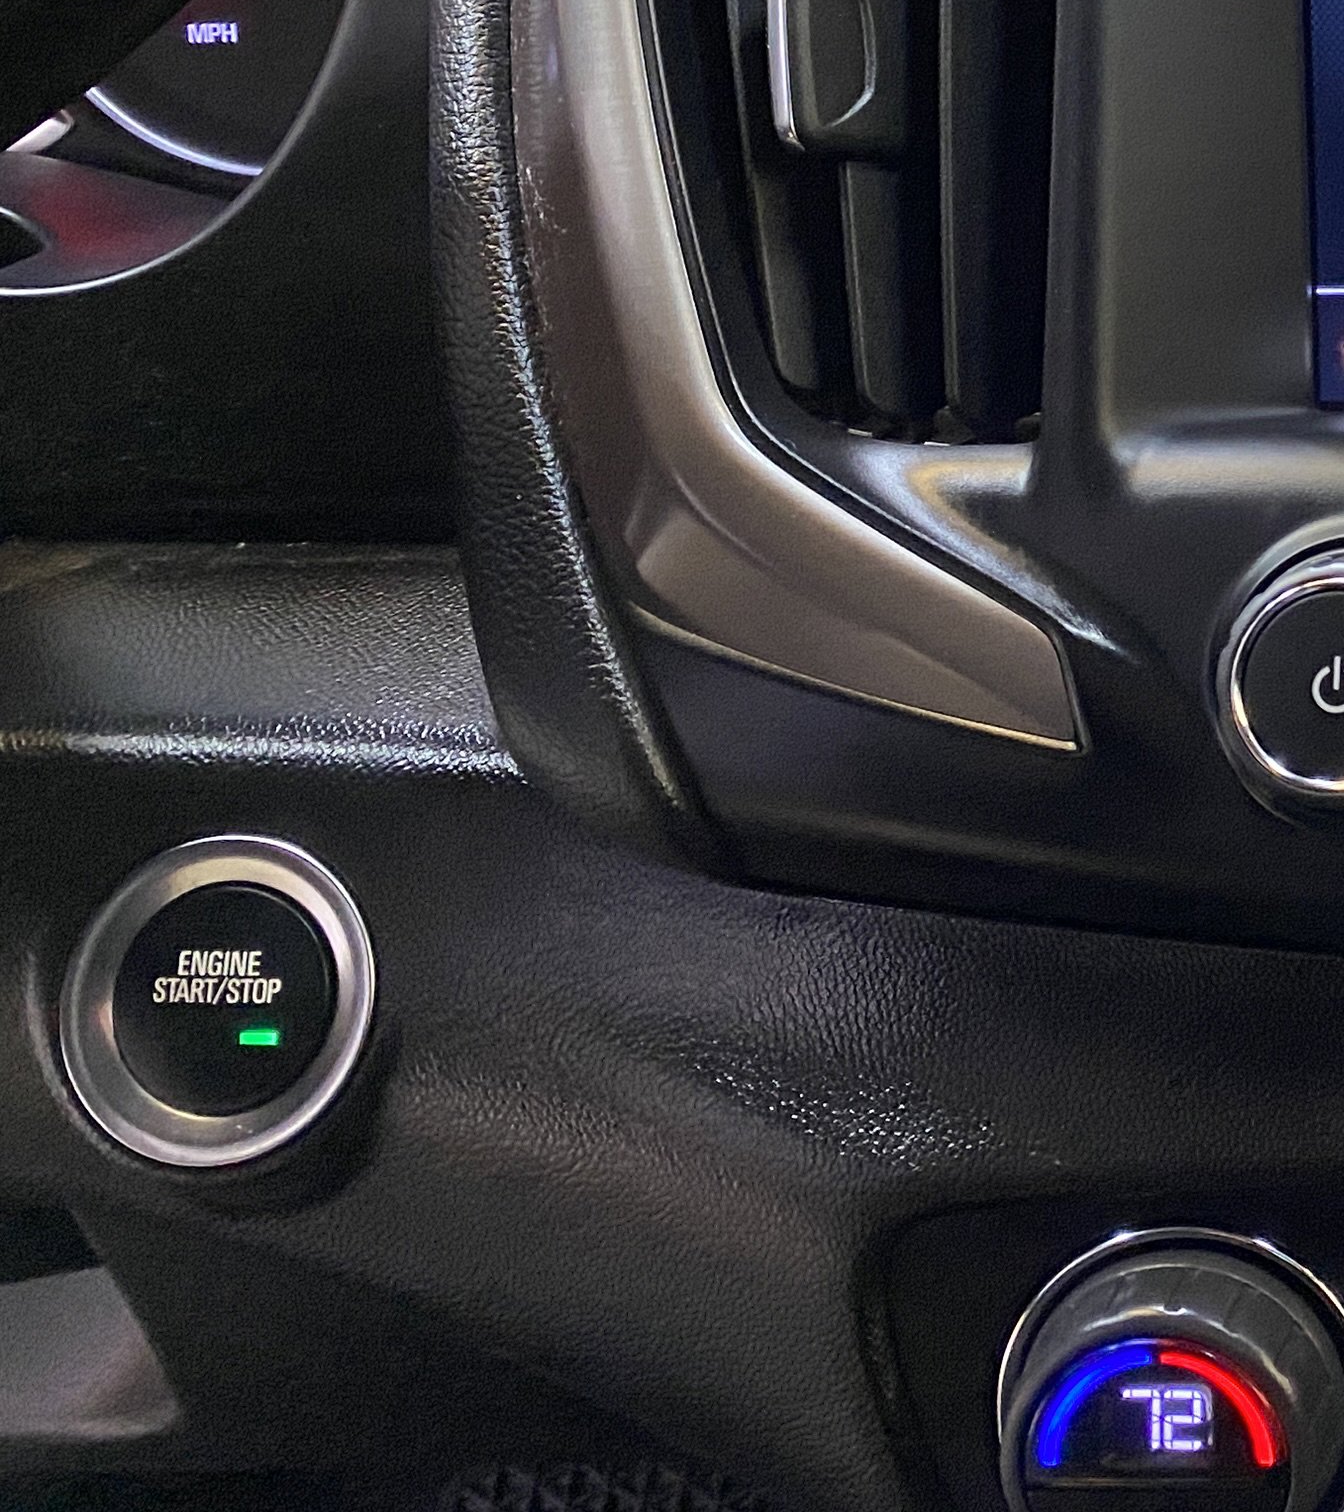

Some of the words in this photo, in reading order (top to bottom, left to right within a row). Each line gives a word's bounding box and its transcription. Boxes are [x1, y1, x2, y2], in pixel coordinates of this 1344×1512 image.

[186, 22, 239, 44] MPH
[177, 949, 263, 977] ENGINE
[152, 977, 282, 1005] START/STOP
[1121, 1387, 1203, 1451] 72
